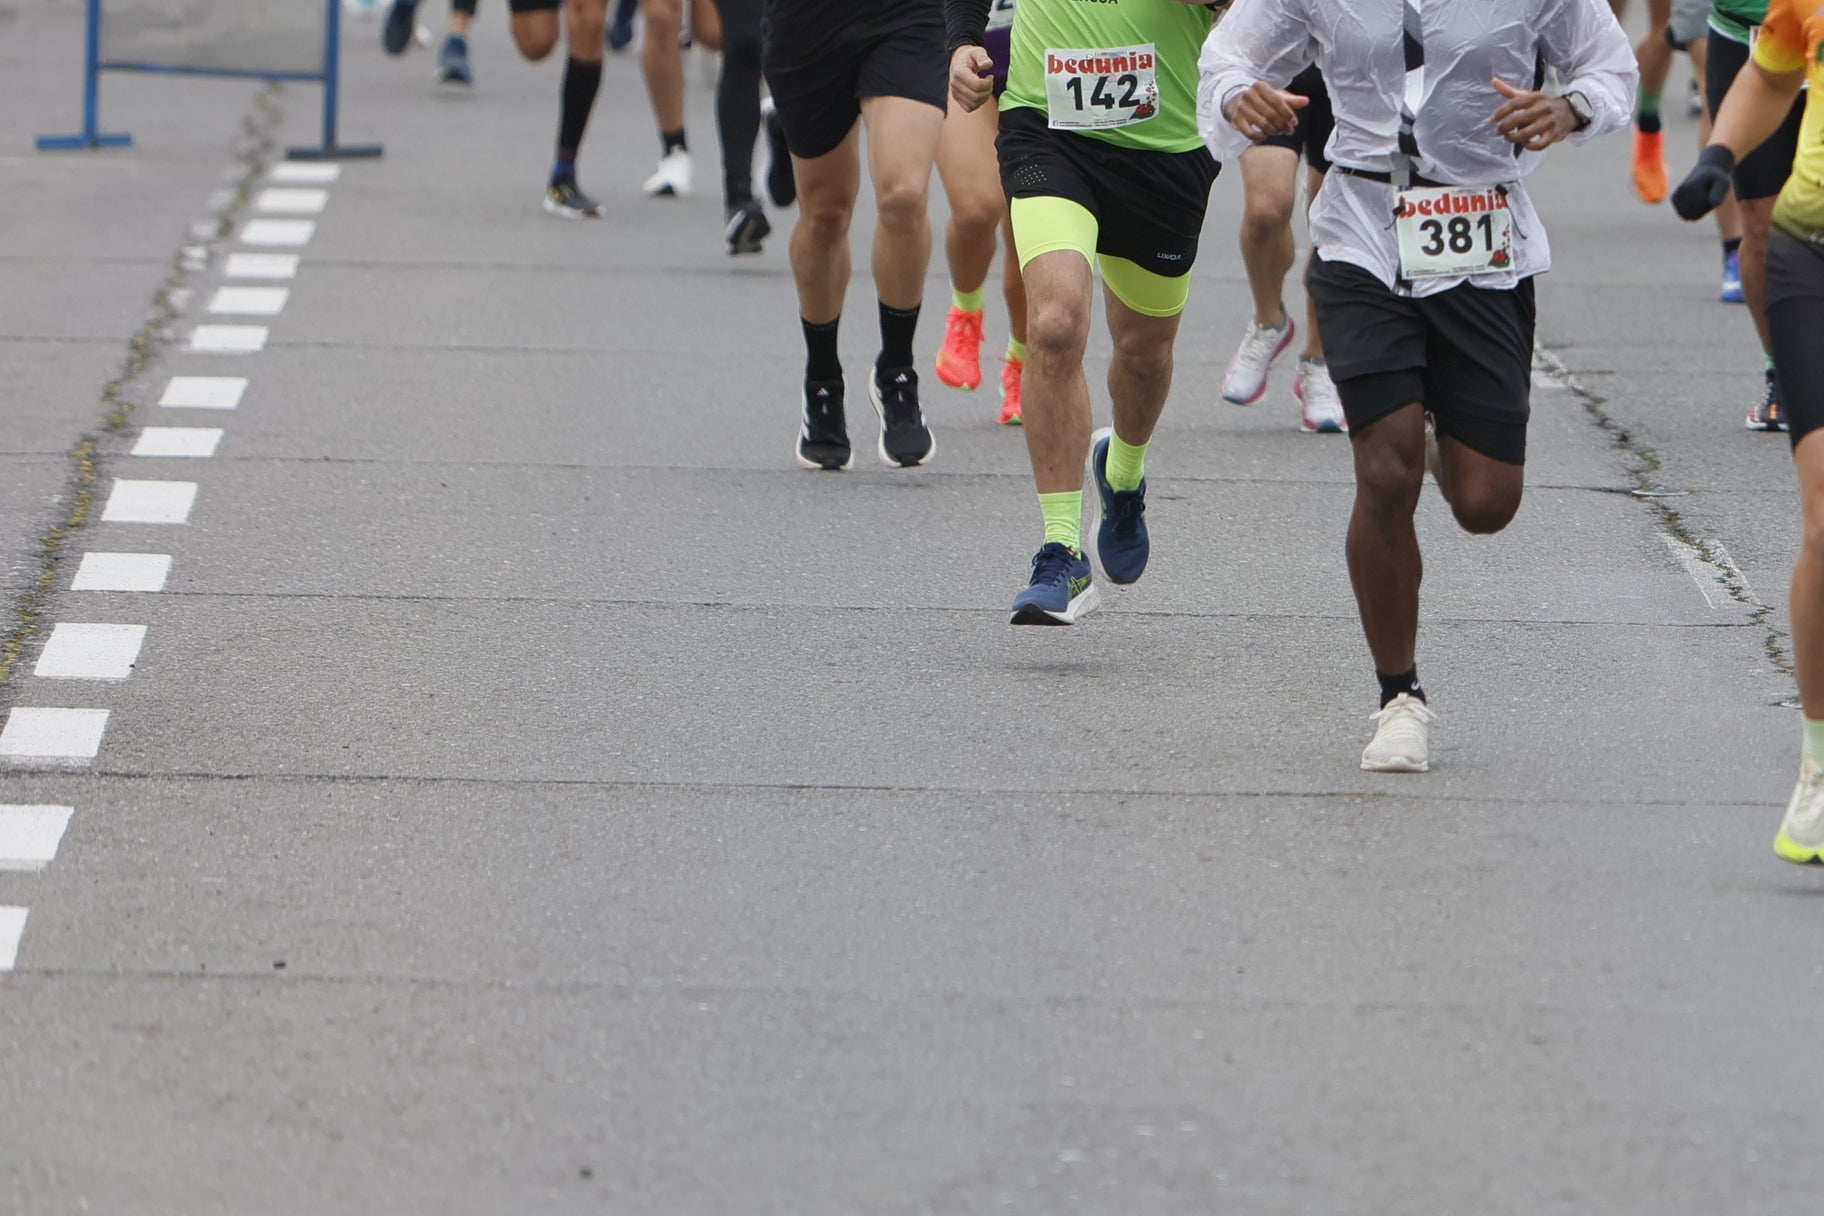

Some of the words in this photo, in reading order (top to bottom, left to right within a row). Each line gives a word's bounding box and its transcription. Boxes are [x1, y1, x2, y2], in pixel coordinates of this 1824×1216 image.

[1048, 51, 1153, 74] bedunia
[1066, 73, 1141, 111] 142
[1399, 189, 1509, 218] bedunia
[1420, 214, 1493, 256] 381
